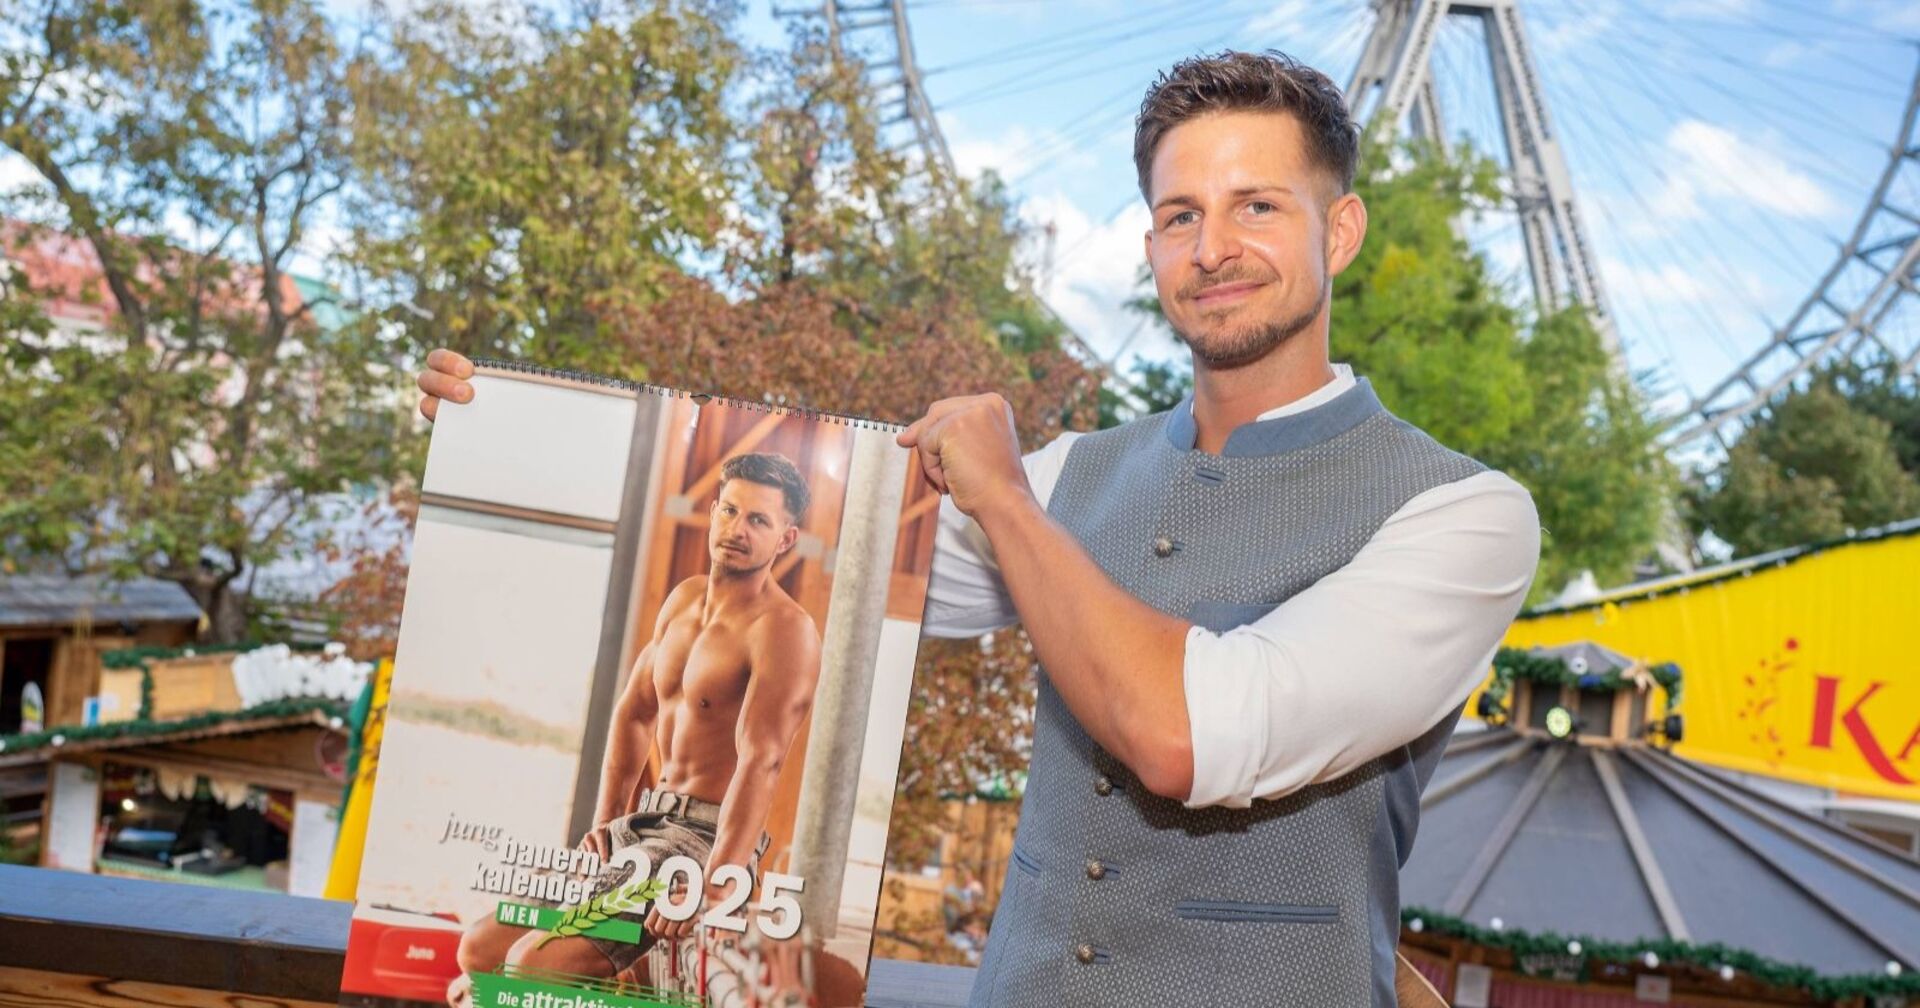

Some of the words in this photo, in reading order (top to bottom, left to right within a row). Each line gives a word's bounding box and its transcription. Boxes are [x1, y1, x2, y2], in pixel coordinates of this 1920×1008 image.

[440, 813, 503, 851] jung
[501, 838, 600, 876] bauern
[471, 862, 598, 905] kalender
[598, 847, 805, 939] 2025
[500, 904, 540, 926] MEN
[497, 991, 519, 1007] Die
